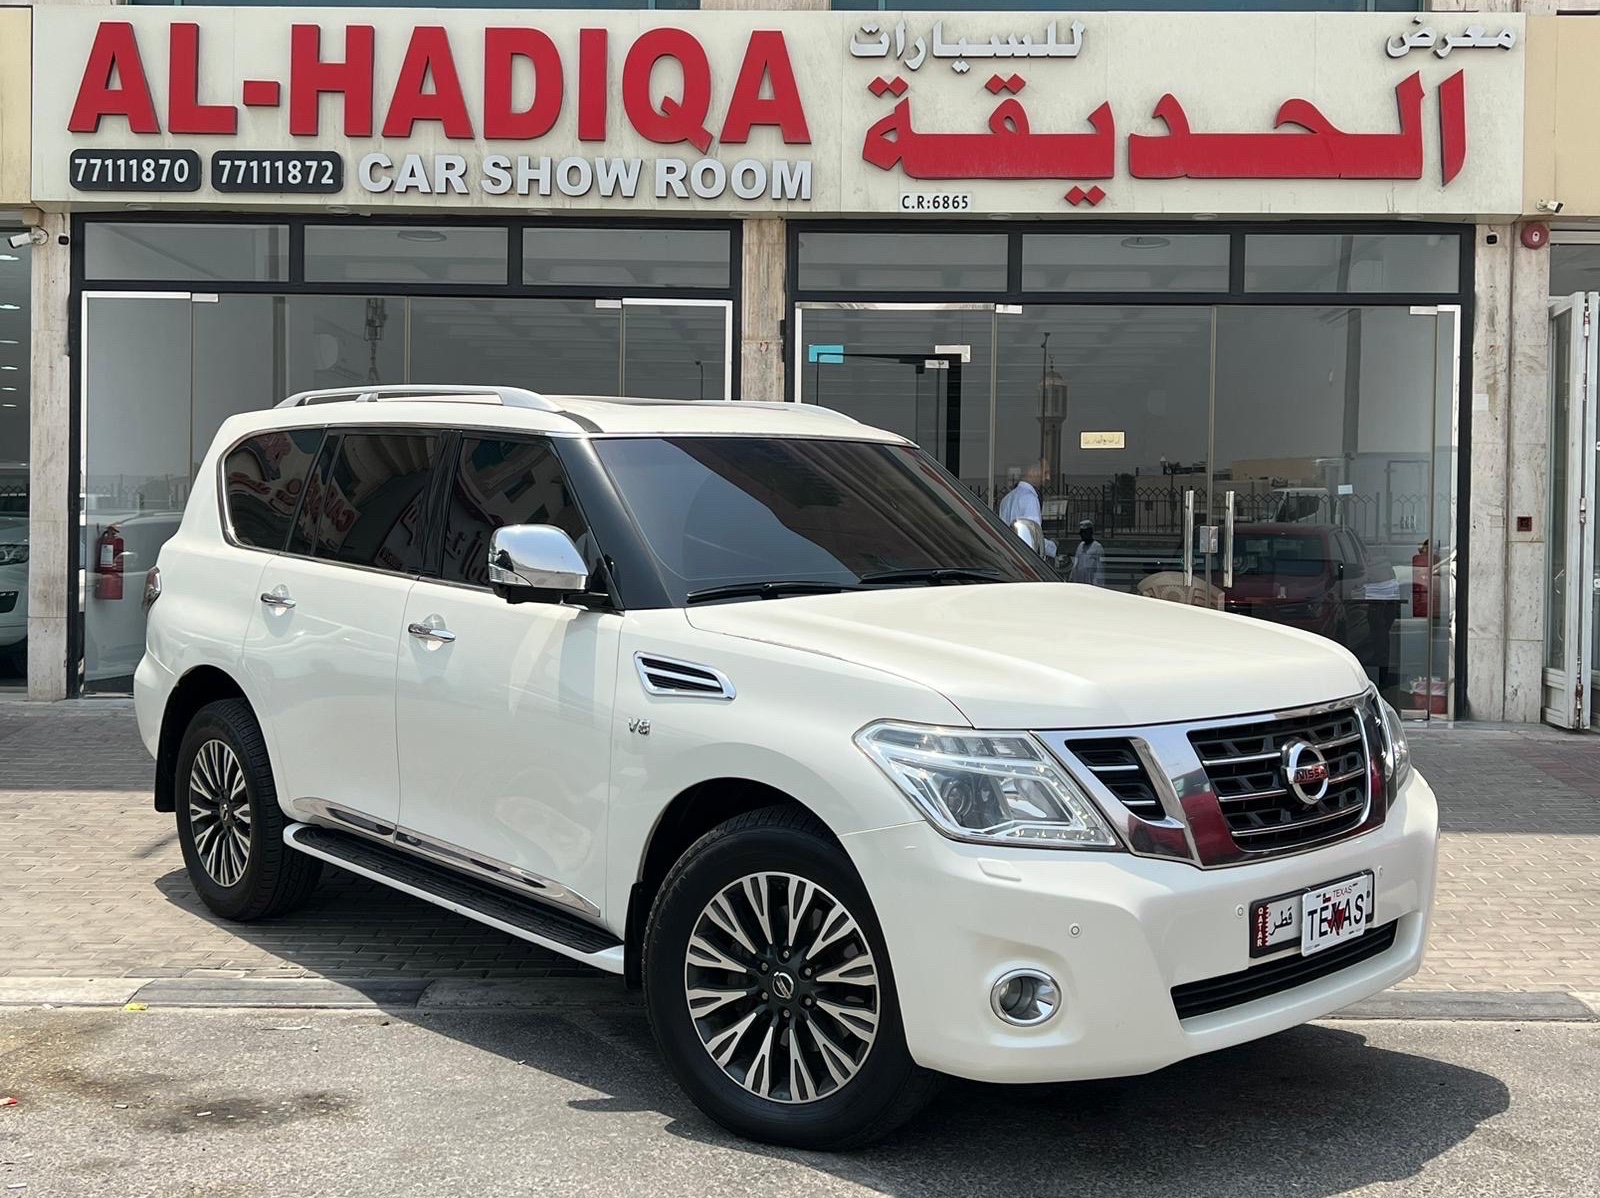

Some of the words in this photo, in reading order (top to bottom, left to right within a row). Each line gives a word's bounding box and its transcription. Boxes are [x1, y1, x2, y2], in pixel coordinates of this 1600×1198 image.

[849, 18, 1086, 73] للسيارات
[1385, 15, 1517, 59] معرض
[68, 22, 812, 154] AL-HADIQA
[862, 69, 1467, 207] الحديقة
[74, 158, 190, 184] 77111870
[218, 160, 335, 185] 77111872
[358, 153, 470, 194] CAR
[480, 155, 643, 197] SHOW
[655, 158, 812, 200] ROOM
[901, 195, 968, 209] C.R:6865
[628, 716, 651, 736] V8
[1332, 885, 1353, 898] TEXAS
[1256, 907, 1264, 947] QATAR
[1268, 906, 1293, 936] قطر
[1307, 893, 1364, 942] TEXAS
